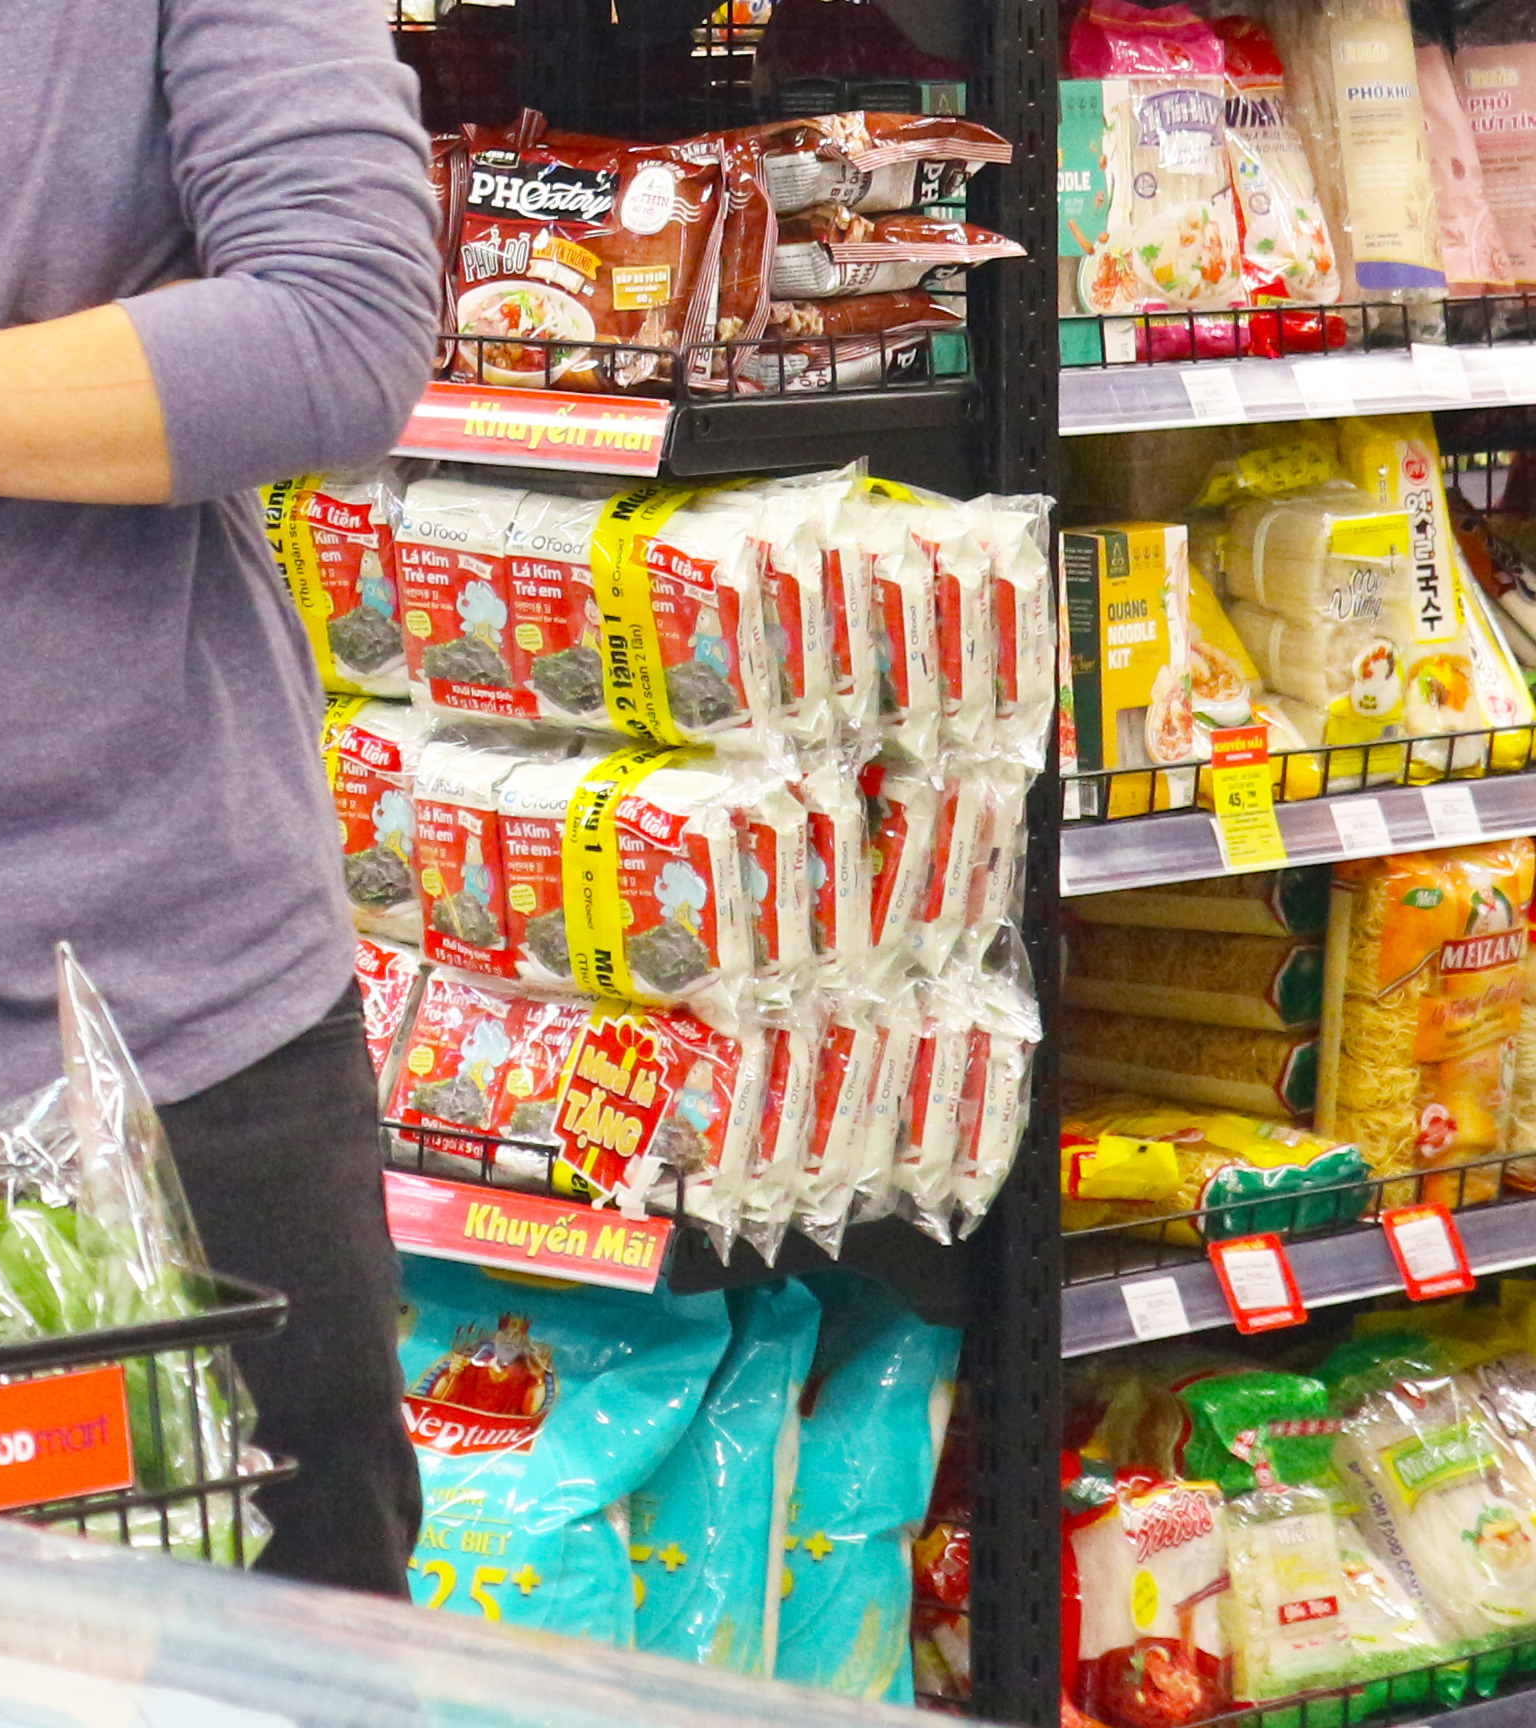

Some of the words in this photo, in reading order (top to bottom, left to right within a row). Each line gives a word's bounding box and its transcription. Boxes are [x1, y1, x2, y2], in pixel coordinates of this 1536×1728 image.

[1348, 81, 1383, 102] PHỞ
[1468, 93, 1511, 113] PHỞ
[463, 402, 585, 449] Khuyến
[593, 406, 655, 454] Mãi
[327, 507, 362, 529] liền
[402, 547, 418, 563] Lá
[421, 551, 450, 568] Kim
[670, 553, 705, 583] liền
[402, 565, 425, 584] Trẻ
[426, 574, 449, 586] em
[512, 561, 530, 579] Lá
[532, 564, 562, 581] Kim
[512, 580, 537, 598] Trẻ
[538, 586, 562, 600] em
[603, 613, 622, 624] 1
[1107, 623, 1157, 647] NOODLE
[609, 634, 636, 690] tặng
[1107, 647, 1132, 670] KIT
[642, 662, 656, 699] scan
[616, 696, 637, 714] 2
[360, 738, 391, 766] liền
[433, 809, 453, 825] Kim
[639, 810, 670, 841] liền
[505, 822, 520, 838] Lá
[522, 824, 551, 840] Kim
[508, 839, 529, 857] Trẻ
[531, 843, 552, 857] em
[1441, 932, 1527, 972] MEIZAN
[577, 1044, 631, 1097] Mua
[630, 1067, 658, 1110] là
[563, 1089, 644, 1158] TẶNG
[463, 1202, 589, 1259] Khuyến
[591, 1223, 658, 1270] Mãi
[403, 1399, 536, 1453] Neptune
[414, 1558, 542, 1623] 25+
